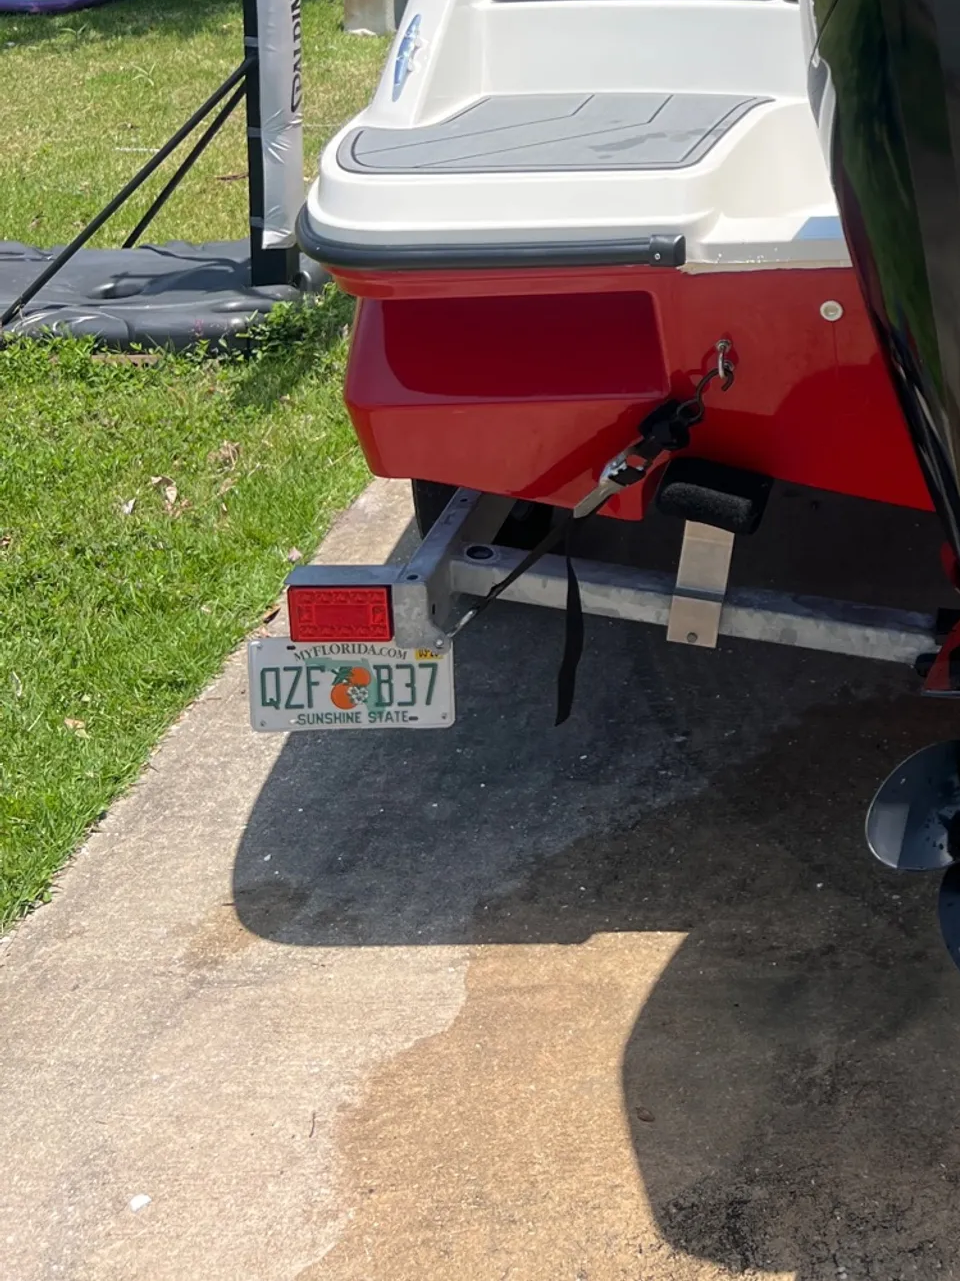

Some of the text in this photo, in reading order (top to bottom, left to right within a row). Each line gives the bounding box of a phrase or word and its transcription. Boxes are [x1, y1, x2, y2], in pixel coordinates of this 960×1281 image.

[293, 643, 408, 661] MYFLORIDA.COM
[260, 662, 438, 710] QZF B37
[296, 711, 409, 725] SUNSHINE STATE
